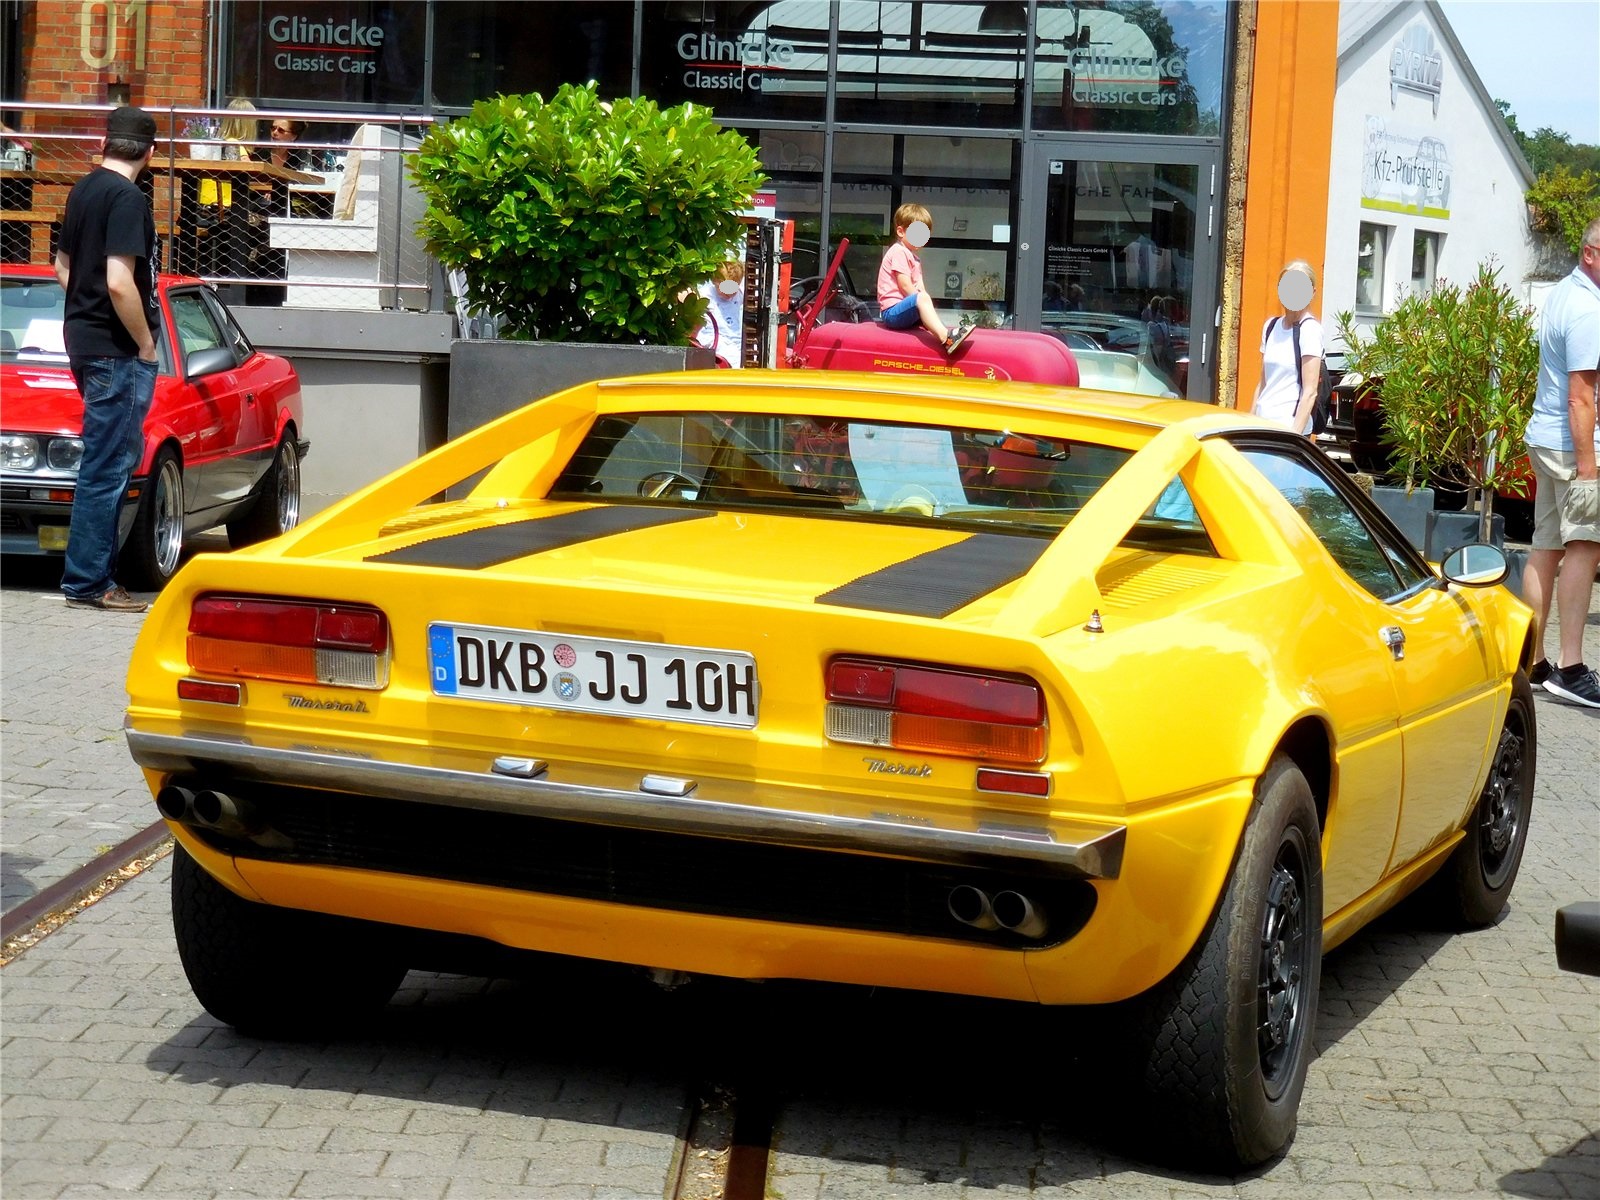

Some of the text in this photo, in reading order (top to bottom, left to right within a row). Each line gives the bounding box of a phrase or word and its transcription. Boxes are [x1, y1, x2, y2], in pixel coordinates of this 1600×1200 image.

[80, 0, 147, 70] 01
[268, 15, 384, 47] Glinicke
[677, 32, 795, 63] Glinicke
[1066, 47, 1185, 78] Glinicke
[274, 53, 377, 75] Classic Cars
[1392, 48, 1442, 84] PYRITZ
[683, 70, 743, 90] Classic
[1072, 86, 1177, 106] Classic Cars
[1373, 150, 1444, 191] Kfz-Prüfstelle
[435, 667, 448, 682] D
[457, 636, 548, 694] DKB
[588, 650, 648, 705] JJ
[664, 658, 756, 717] 10H
